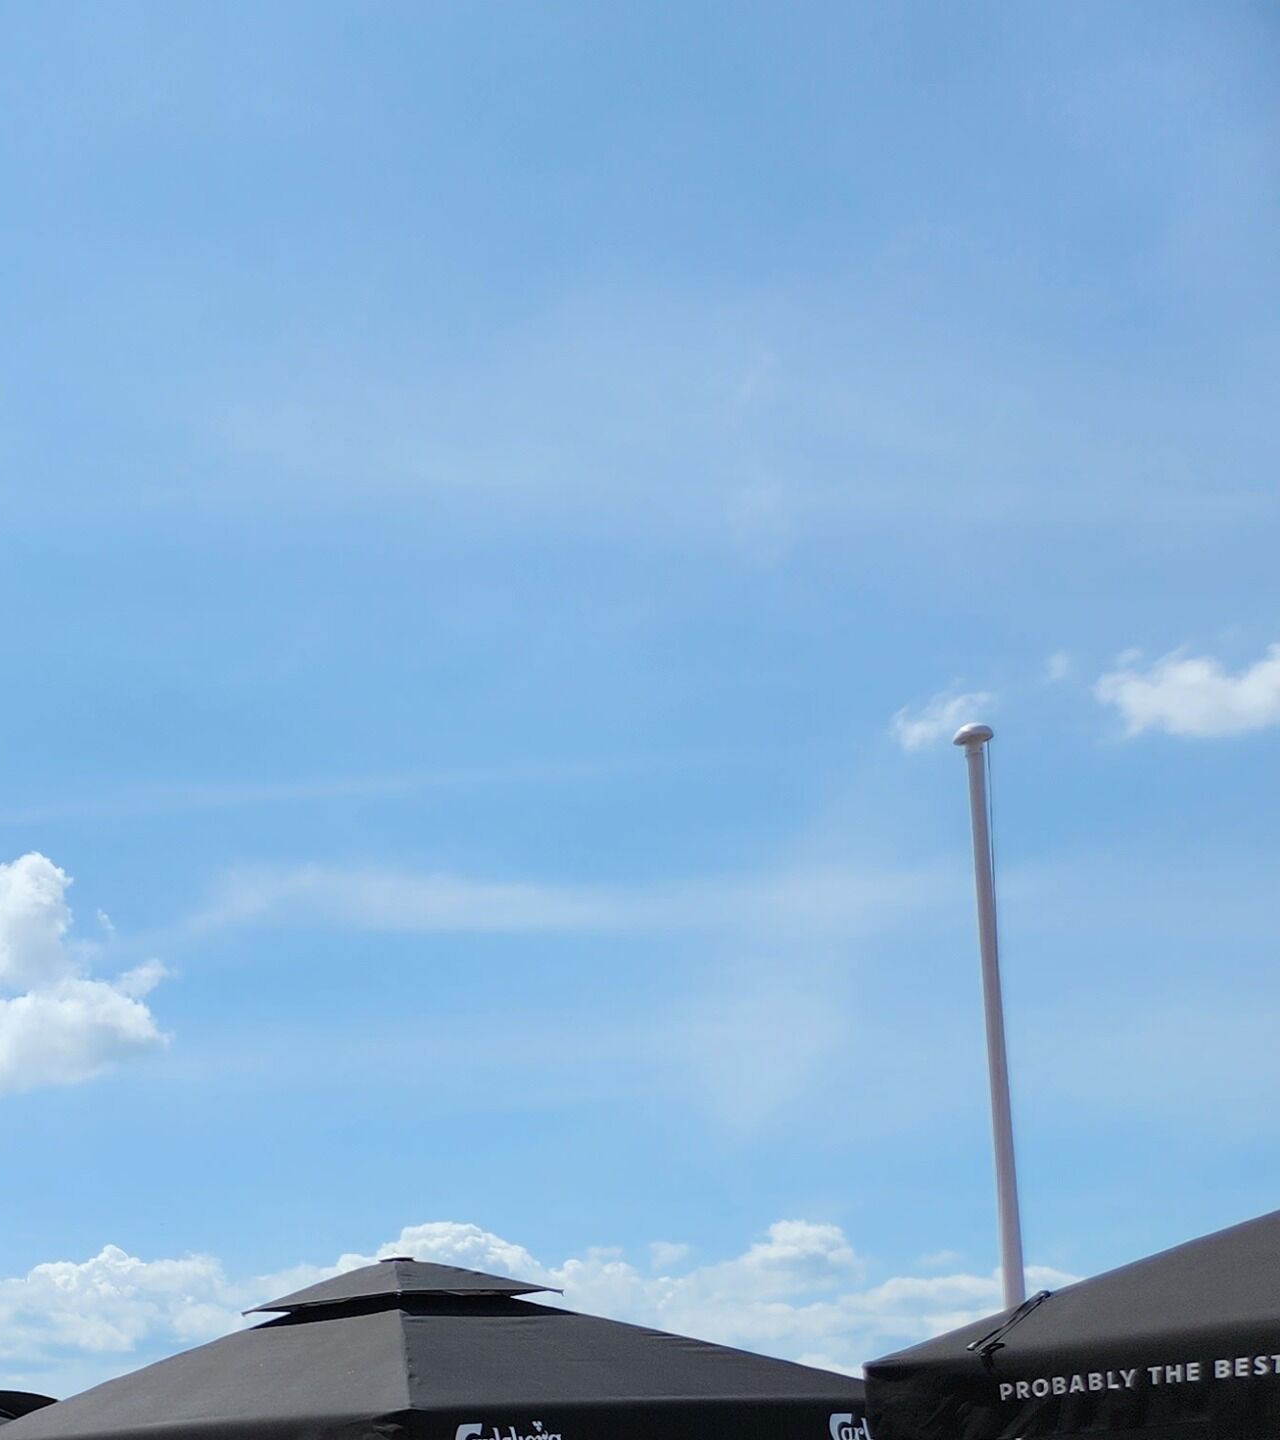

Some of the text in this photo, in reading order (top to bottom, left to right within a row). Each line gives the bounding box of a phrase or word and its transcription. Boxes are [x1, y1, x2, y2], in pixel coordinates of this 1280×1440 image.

[998, 1352, 1280, 1401] PROBABLY THE BEST
